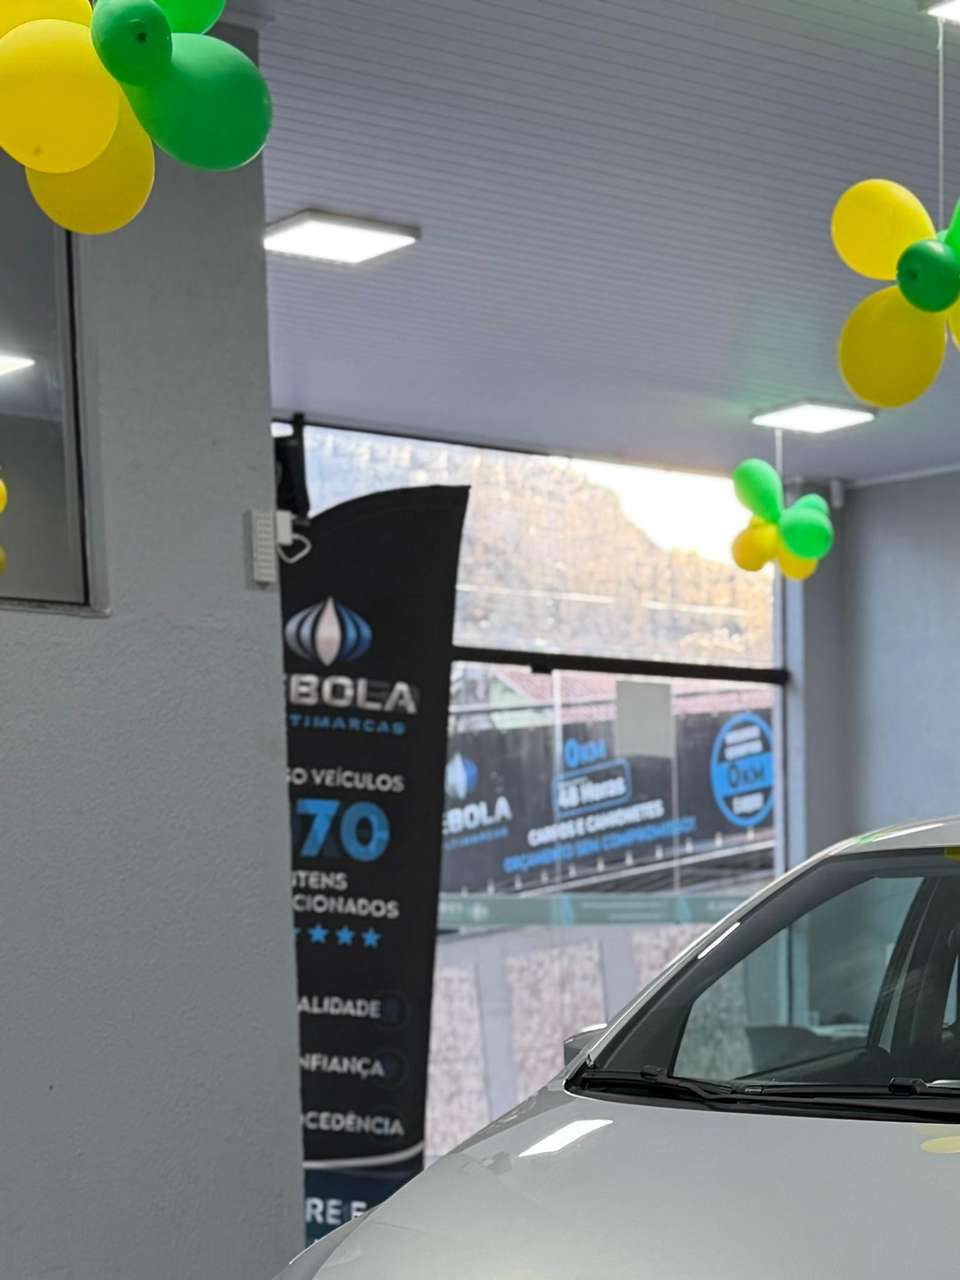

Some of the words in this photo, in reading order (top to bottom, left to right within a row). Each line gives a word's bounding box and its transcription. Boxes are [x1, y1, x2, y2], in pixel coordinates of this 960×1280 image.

[286, 672, 417, 715] BOLA
[289, 712, 406, 737] TIMARCAS
[310, 766, 406, 793] VEÍCULOS
[296, 798, 391, 863] 70
[292, 893, 400, 920] CIONADOS
[297, 995, 382, 1019] ALIDADE
[300, 1052, 386, 1080] NFIANÇA
[301, 1110, 406, 1137] CEDÊNCIA
[305, 1197, 342, 1225] RE
